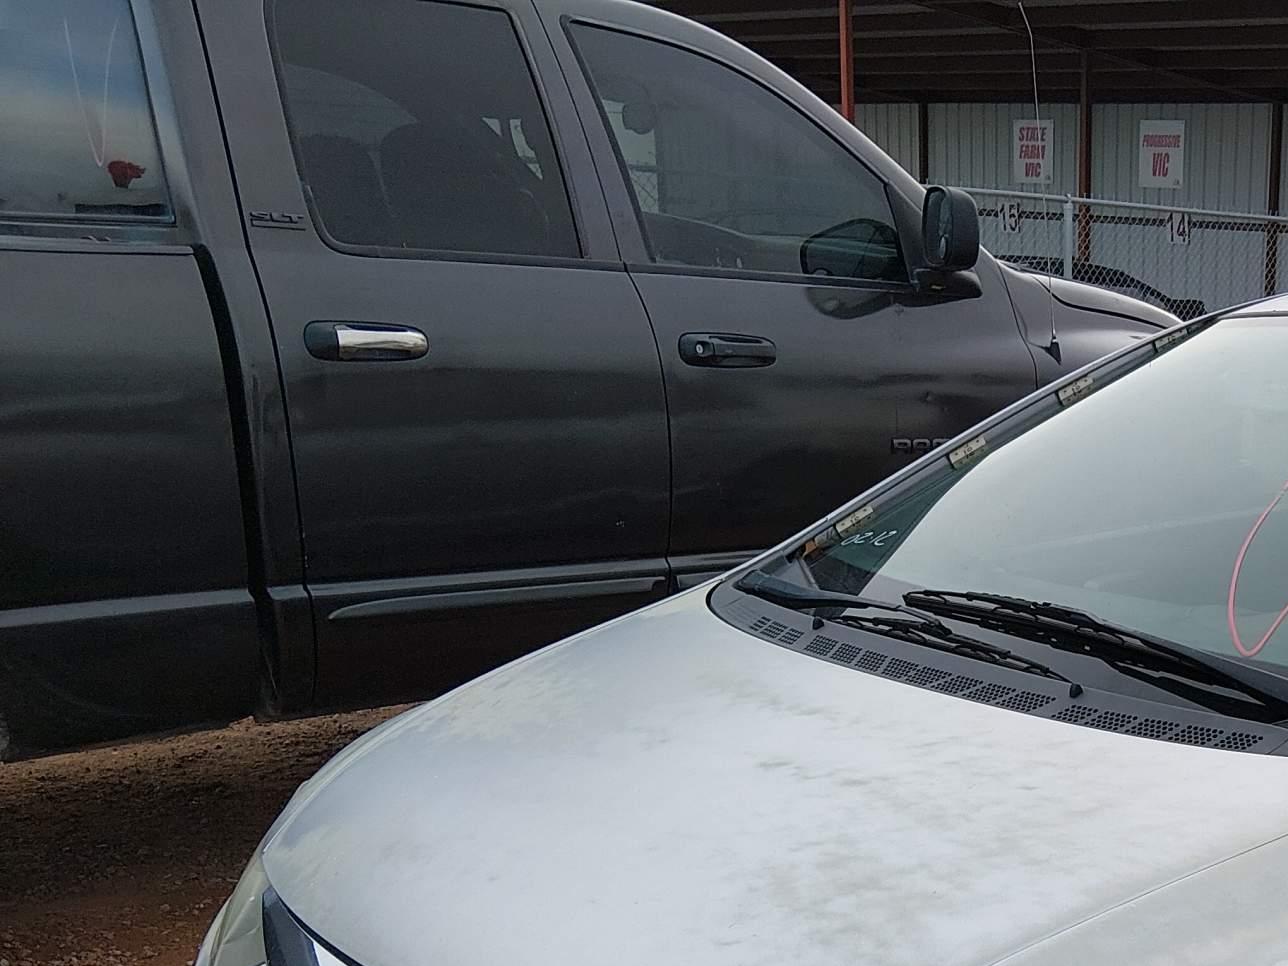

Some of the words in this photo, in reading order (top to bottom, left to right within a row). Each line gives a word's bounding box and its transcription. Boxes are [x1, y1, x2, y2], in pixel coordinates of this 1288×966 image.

[1019, 127, 1047, 142] STATE
[1019, 144, 1046, 160] FARM
[1025, 162, 1042, 178] VIC
[1152, 152, 1170, 177] VIC
